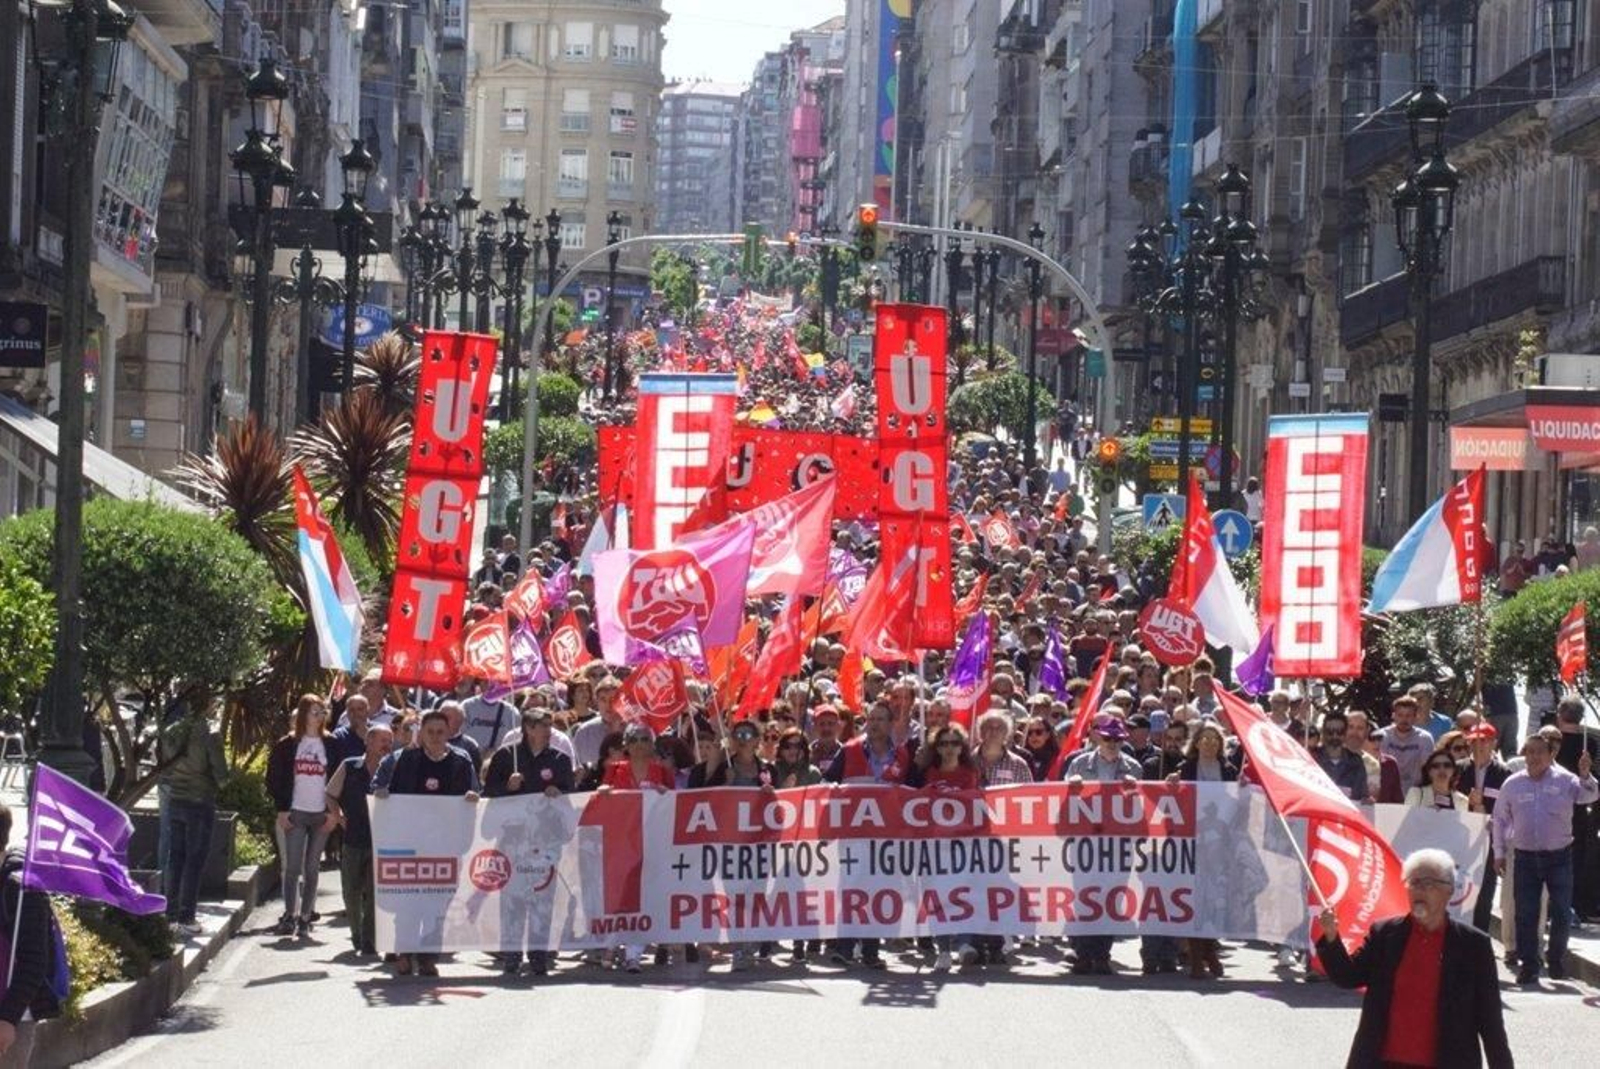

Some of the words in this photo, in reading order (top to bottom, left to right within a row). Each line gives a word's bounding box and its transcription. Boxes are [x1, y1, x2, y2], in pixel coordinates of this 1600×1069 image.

[1151, 603, 1199, 641] UGT
[685, 802, 717, 833] A
[738, 797, 885, 832] LOITA
[382, 862, 452, 879] CCOO
[578, 794, 643, 915] 1
[702, 841, 829, 880] DEREITOS
[871, 838, 1020, 875] IGUALDADE
[590, 915, 652, 935] MAIO
[670, 888, 903, 930] PRIMEIRO
[917, 887, 974, 924] AS
[987, 886, 1194, 924] PERSOAS
